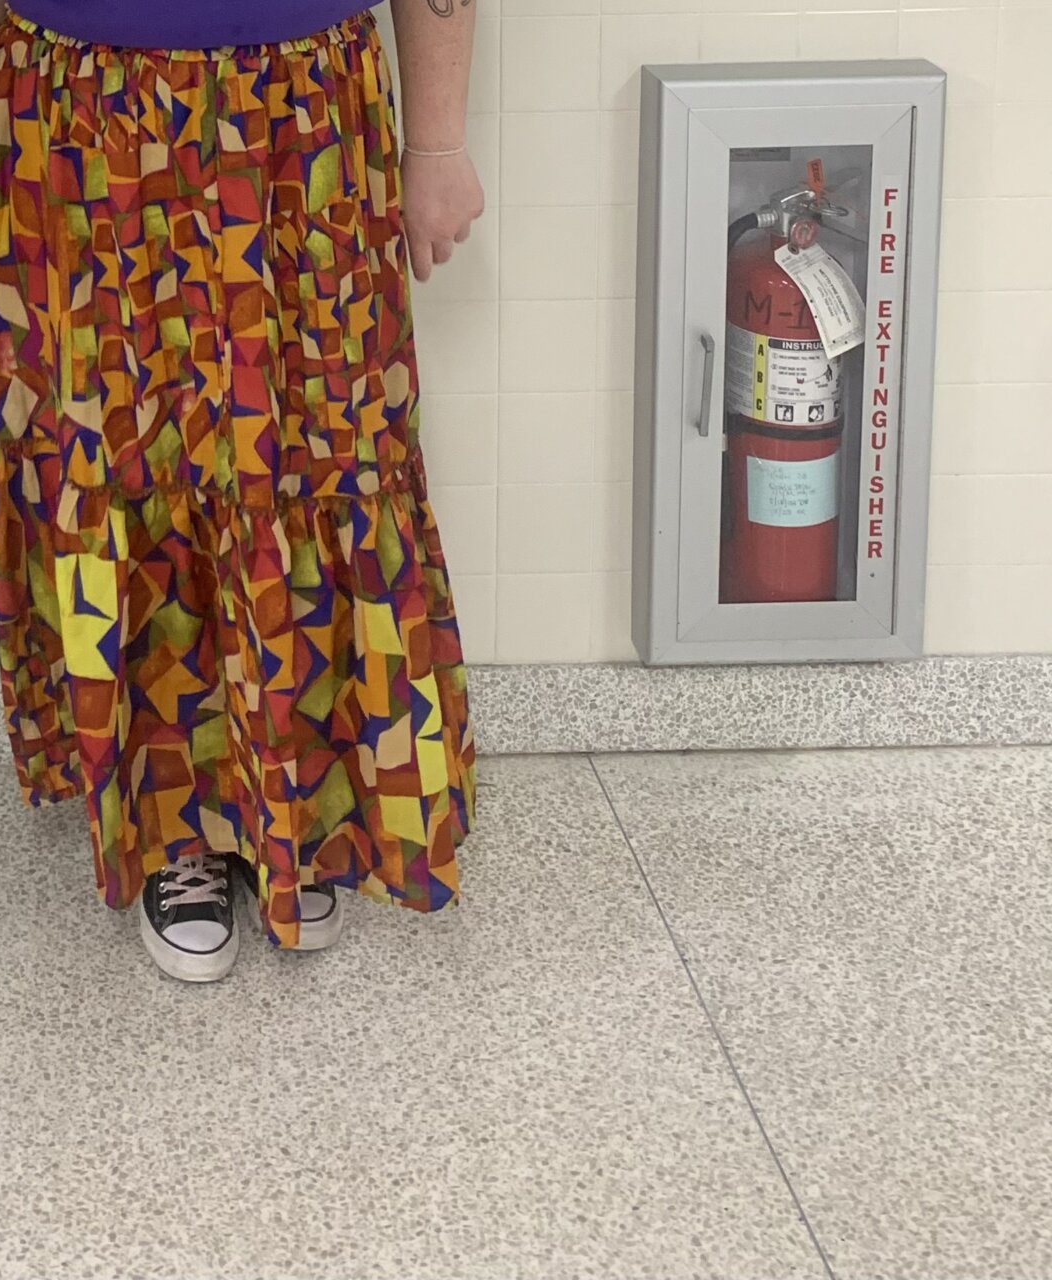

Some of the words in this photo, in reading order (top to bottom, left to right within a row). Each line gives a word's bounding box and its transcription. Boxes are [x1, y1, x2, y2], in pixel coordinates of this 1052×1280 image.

[880, 188, 898, 274] FIRE
[758, 344, 764, 356] A
[757, 372, 763, 383] B
[756, 398, 762, 410] C
[868, 300, 893, 558] EXTINGUISHER
